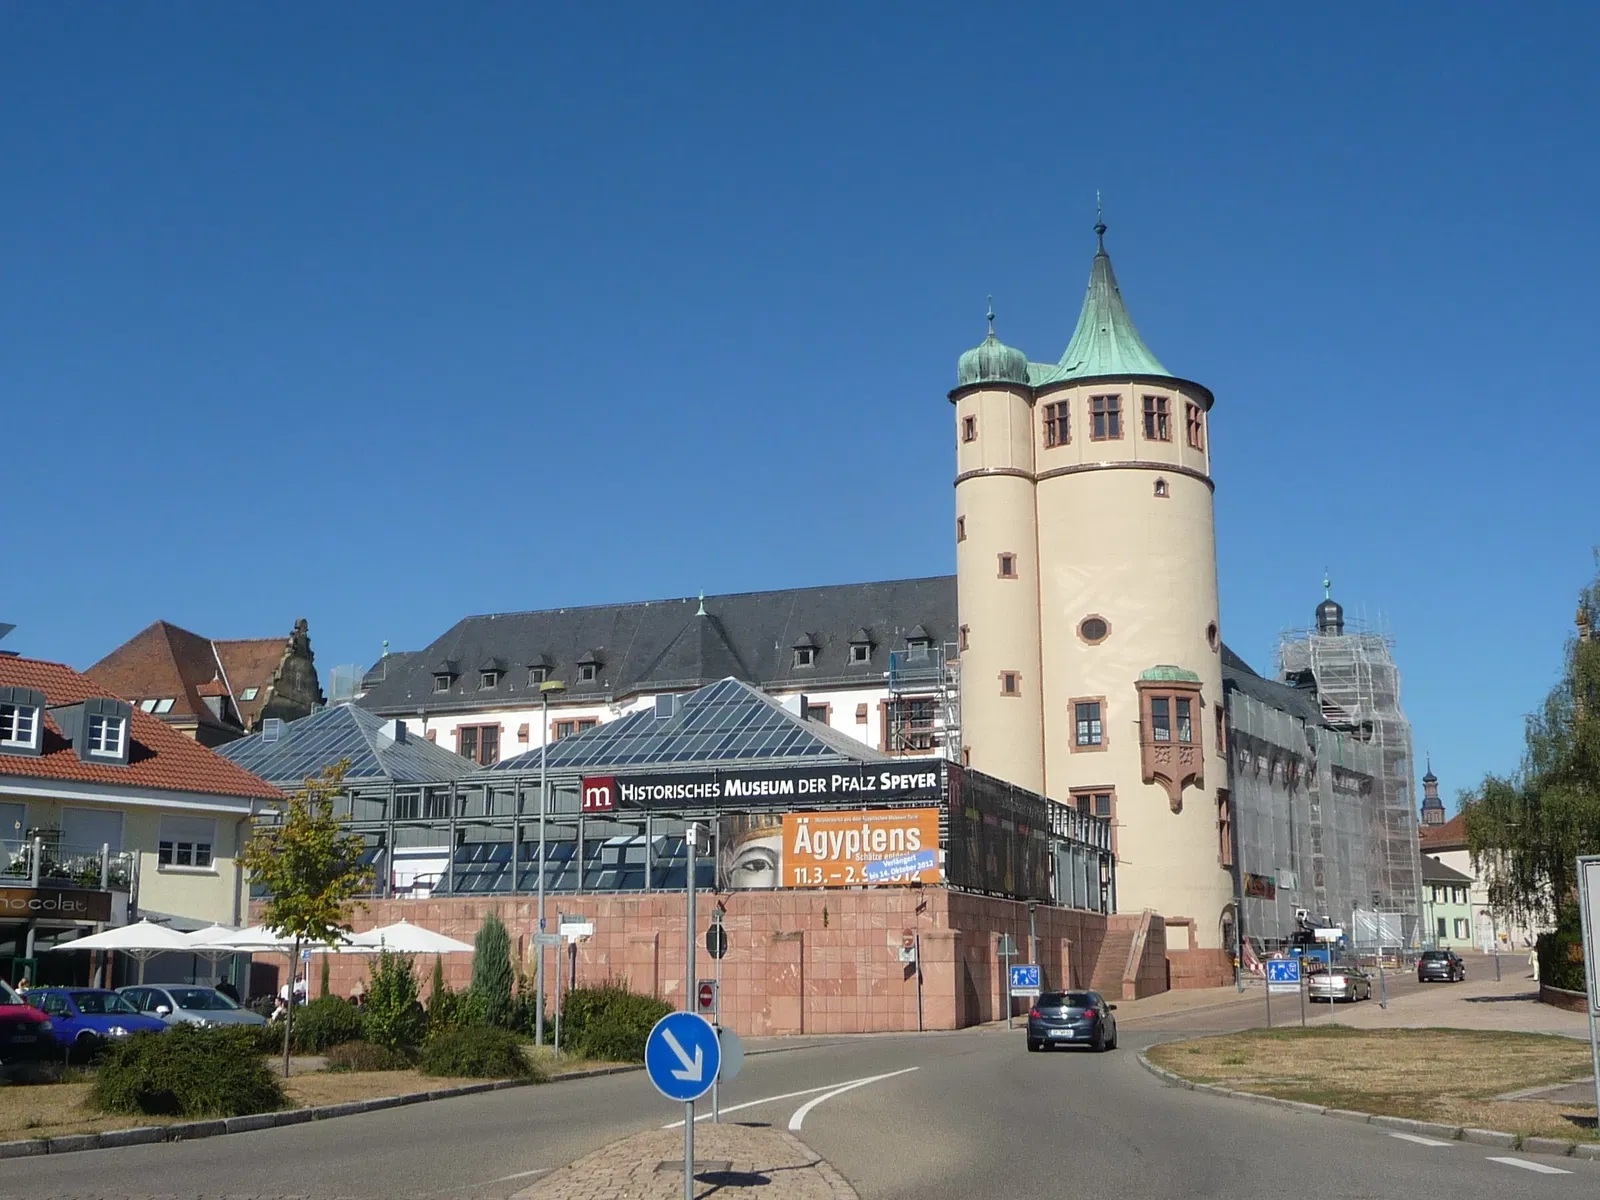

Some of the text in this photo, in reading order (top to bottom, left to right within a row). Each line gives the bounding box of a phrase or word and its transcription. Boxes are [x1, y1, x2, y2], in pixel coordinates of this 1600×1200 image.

[583, 785, 612, 808] m
[724, 779, 794, 797] MUSEUM
[798, 777, 827, 794] DER
[831, 774, 876, 793] PFALZ
[880, 772, 937, 791] SPEYER
[793, 817, 921, 861] Ägyptens
[869, 871, 879, 880] bis
[890, 864, 916, 875] Oktober
[917, 859, 934, 870] 2012
[882, 854, 917, 868] Verlängert
[793, 867, 828, 884] 11.3.
